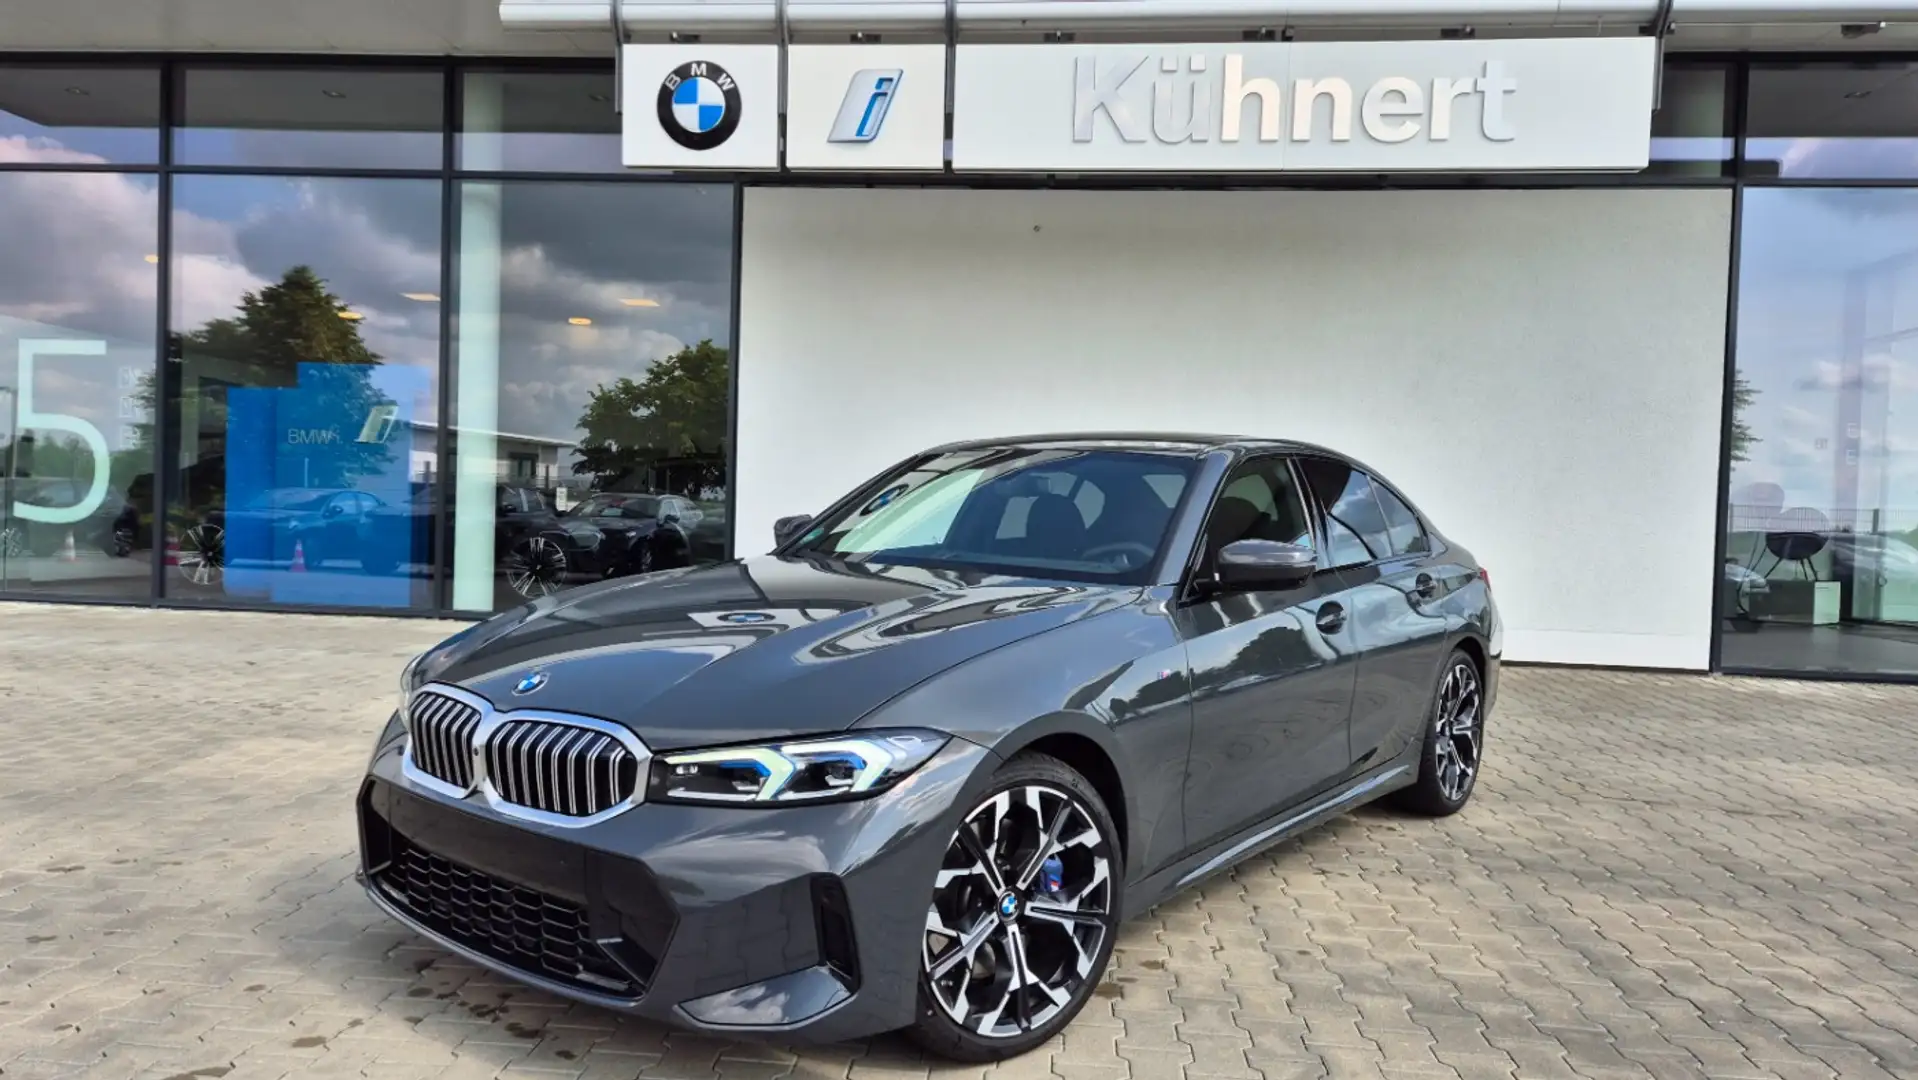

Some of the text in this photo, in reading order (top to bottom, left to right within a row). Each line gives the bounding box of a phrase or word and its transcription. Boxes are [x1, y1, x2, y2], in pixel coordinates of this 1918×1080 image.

[664, 62, 735, 91] BMW
[1072, 54, 1517, 144] Kühnert
[13, 338, 110, 524] 5
